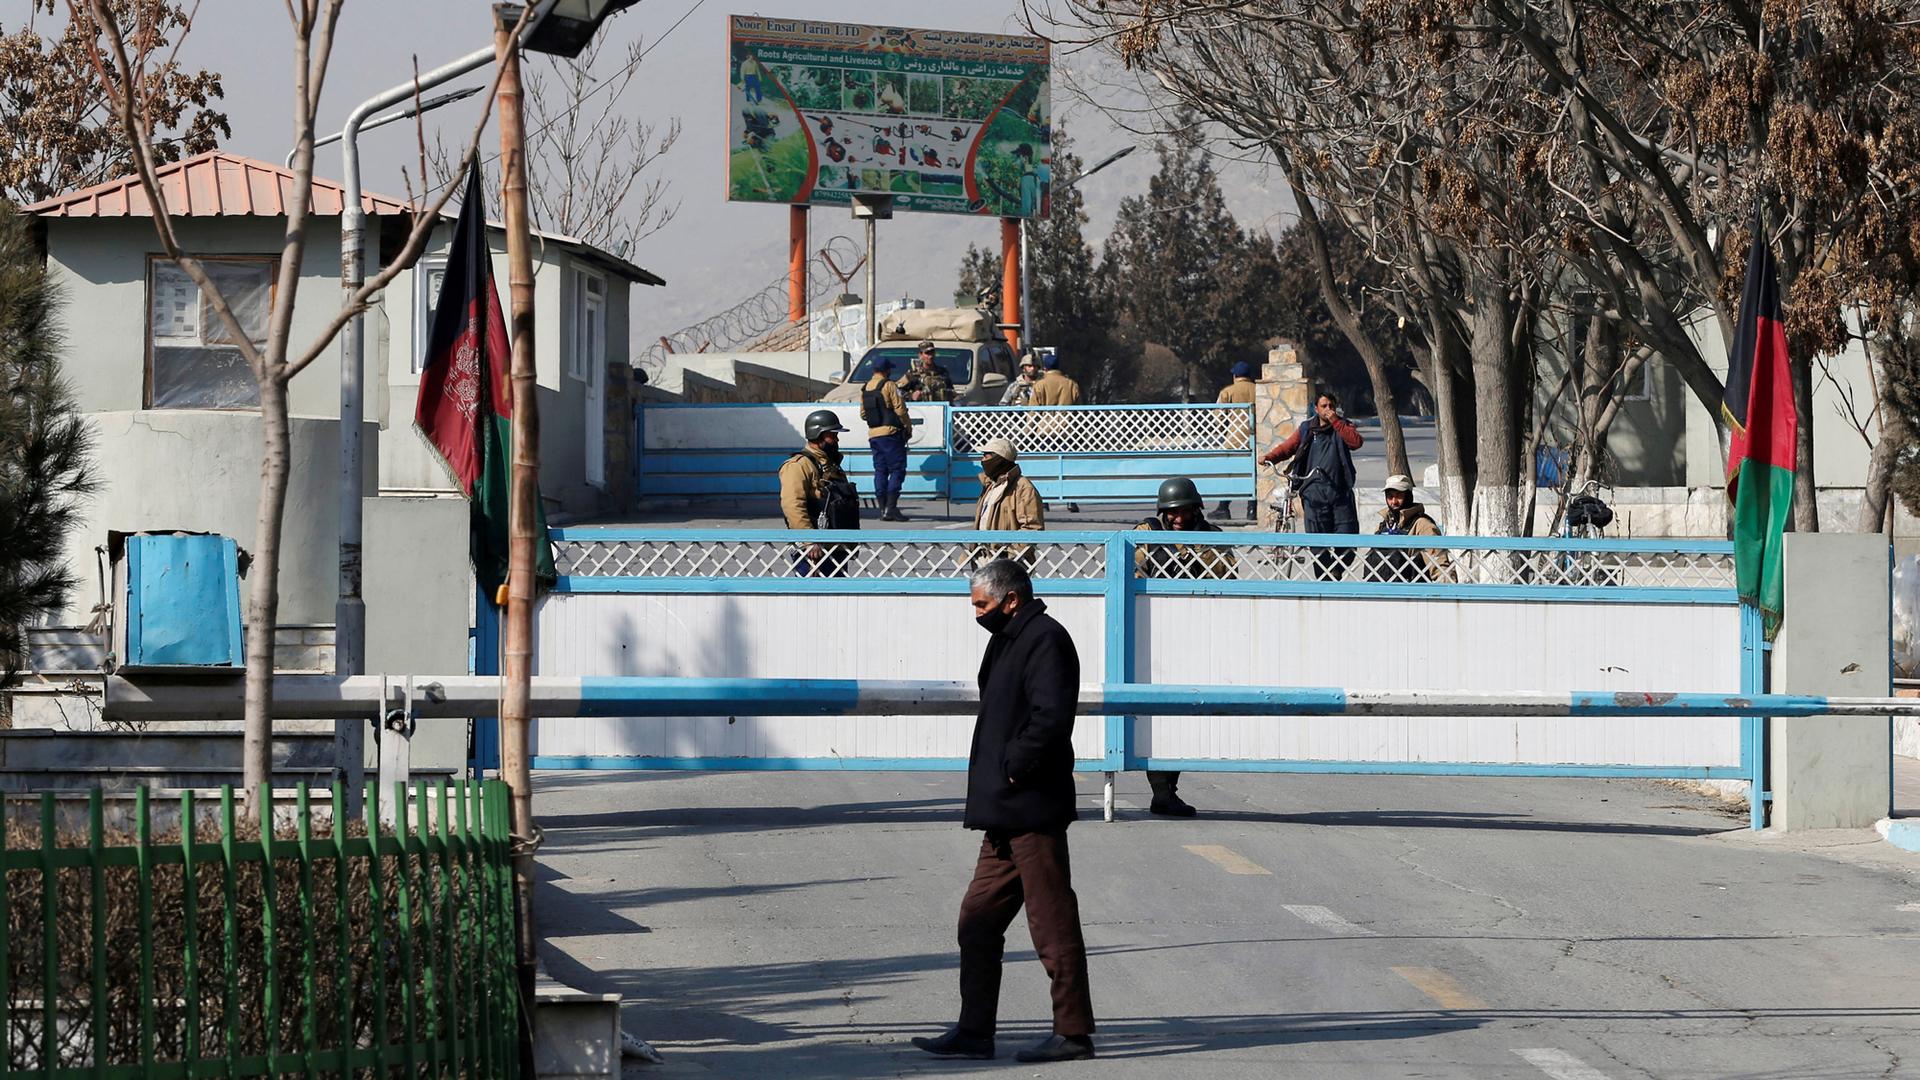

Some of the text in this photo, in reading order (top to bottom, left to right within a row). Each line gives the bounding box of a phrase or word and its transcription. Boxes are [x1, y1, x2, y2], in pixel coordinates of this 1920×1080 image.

[736, 18, 860, 37] Noor Ensaf Tarin LTD
[757, 49, 882, 66] Roots Agricultural and Livestock
[928, 61, 960, 73] مالداری
[996, 65, 1024, 76] خدمات
